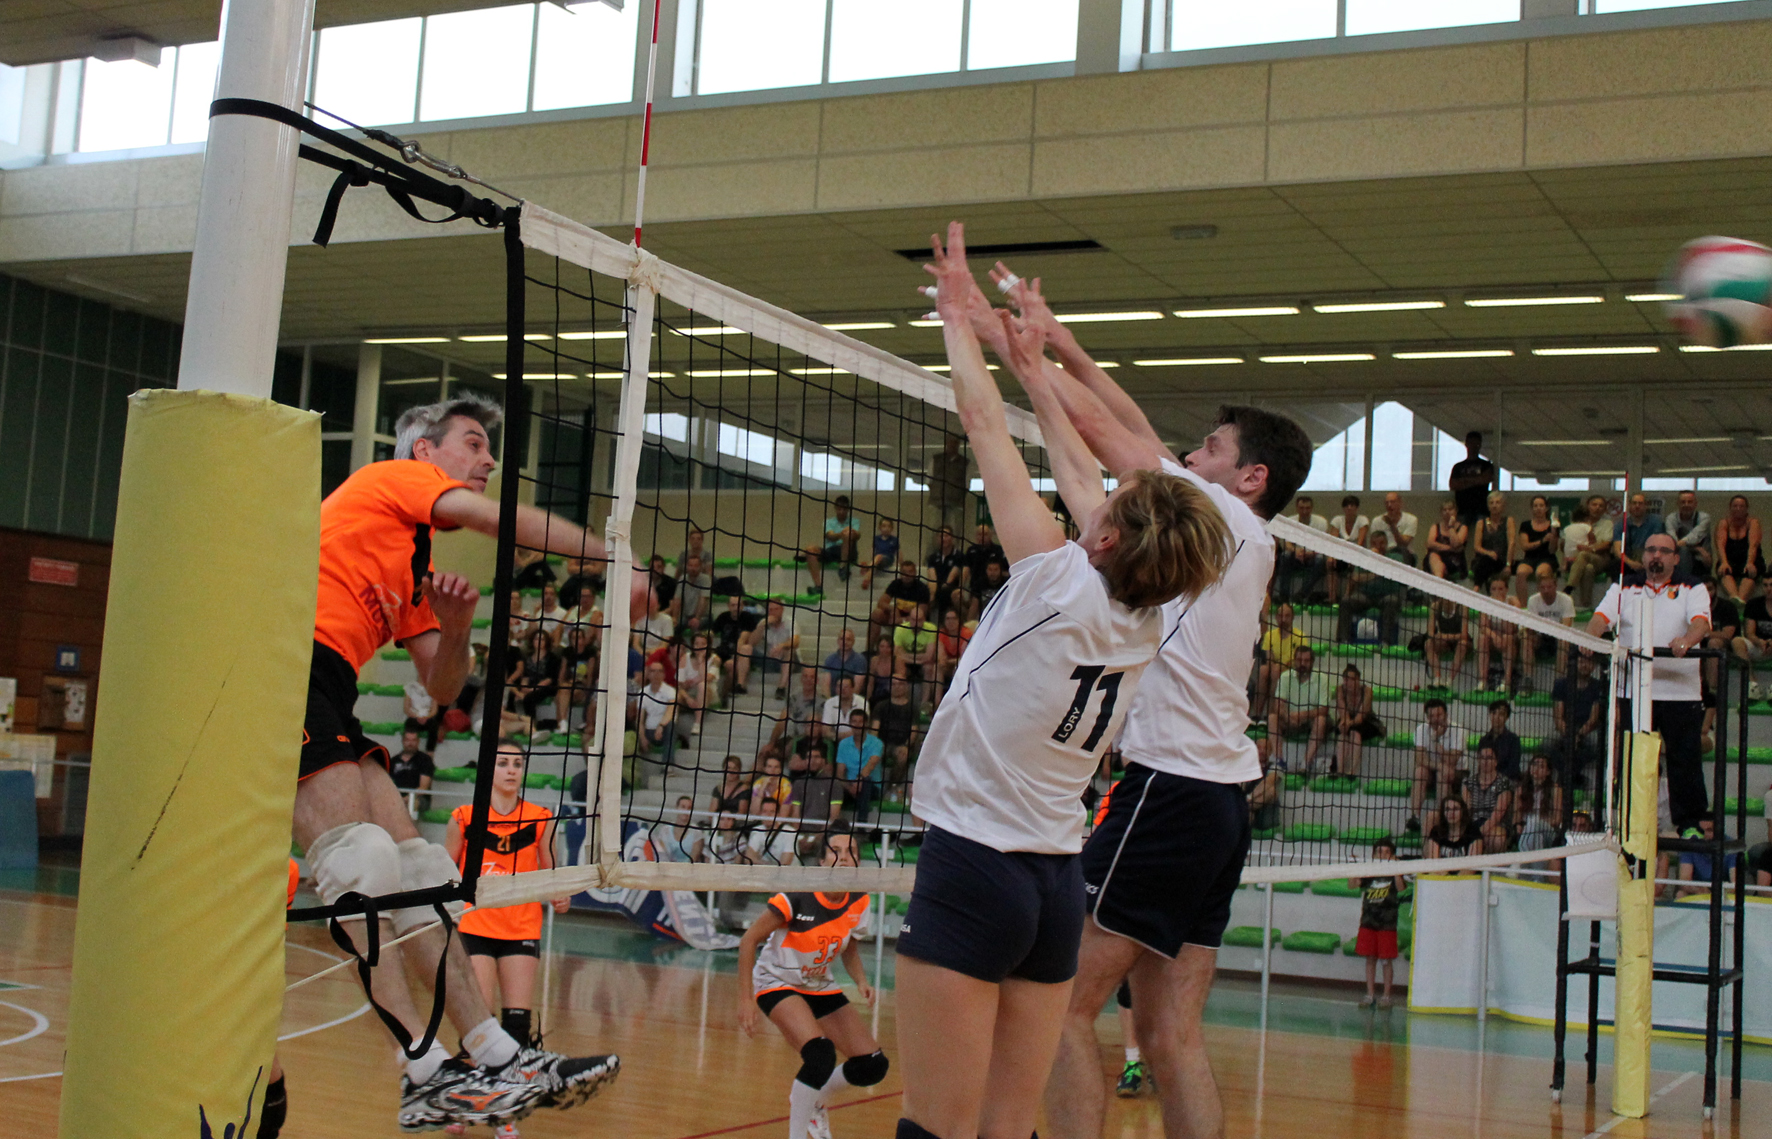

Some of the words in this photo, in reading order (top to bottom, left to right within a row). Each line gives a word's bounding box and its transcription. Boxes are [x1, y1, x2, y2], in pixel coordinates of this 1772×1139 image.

[1051, 665, 1125, 753] 11
[1058, 707, 1080, 738] LORY
[497, 835, 511, 852] 21
[813, 935, 843, 965] 33
